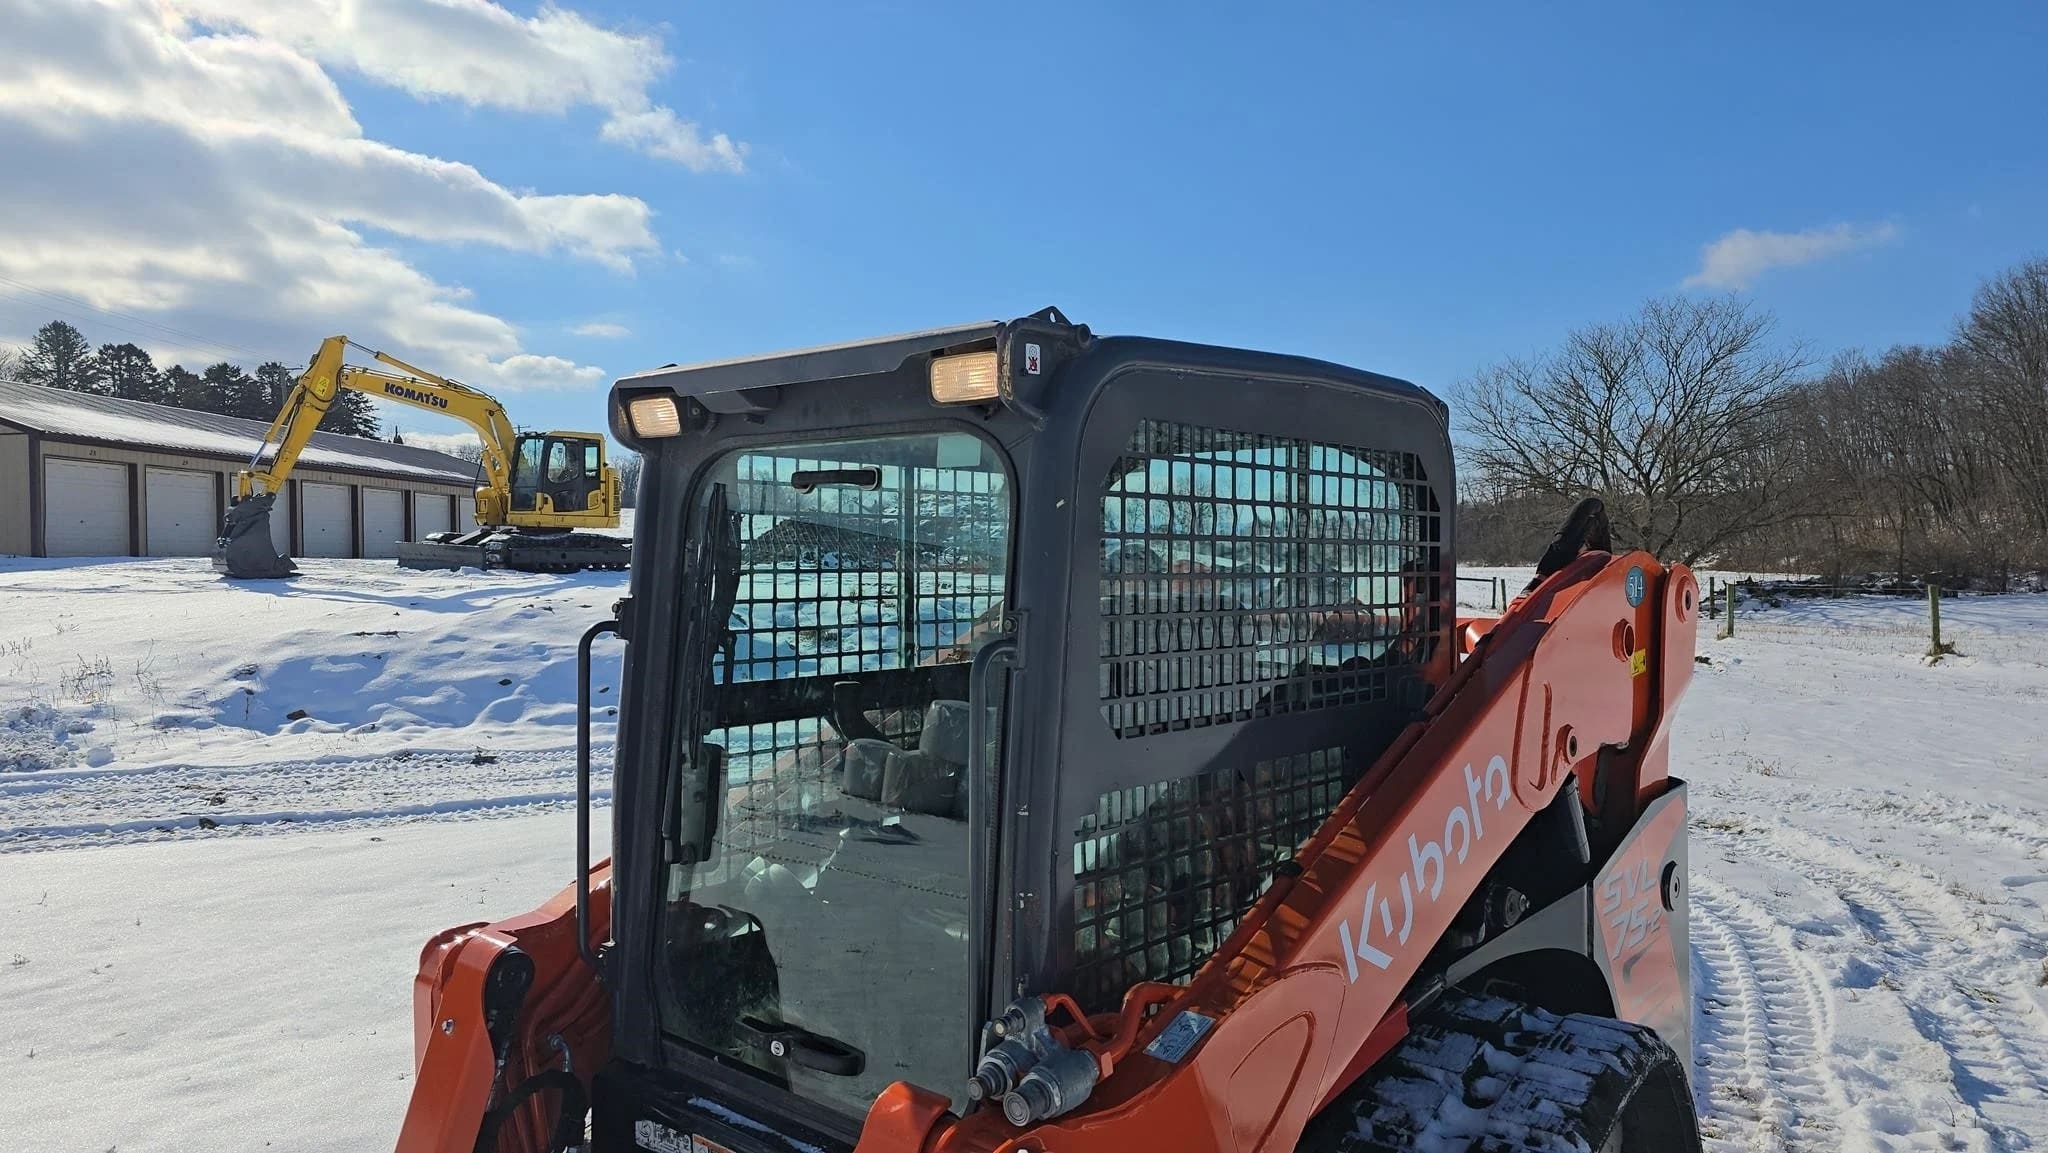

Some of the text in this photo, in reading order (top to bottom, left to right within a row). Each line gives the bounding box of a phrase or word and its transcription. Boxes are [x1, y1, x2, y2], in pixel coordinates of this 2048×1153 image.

[384, 382, 448, 408] KOMATSU
[1629, 576, 1643, 598] 514
[1339, 755, 1511, 984] Kubota
[1603, 858, 1657, 916] SVL
